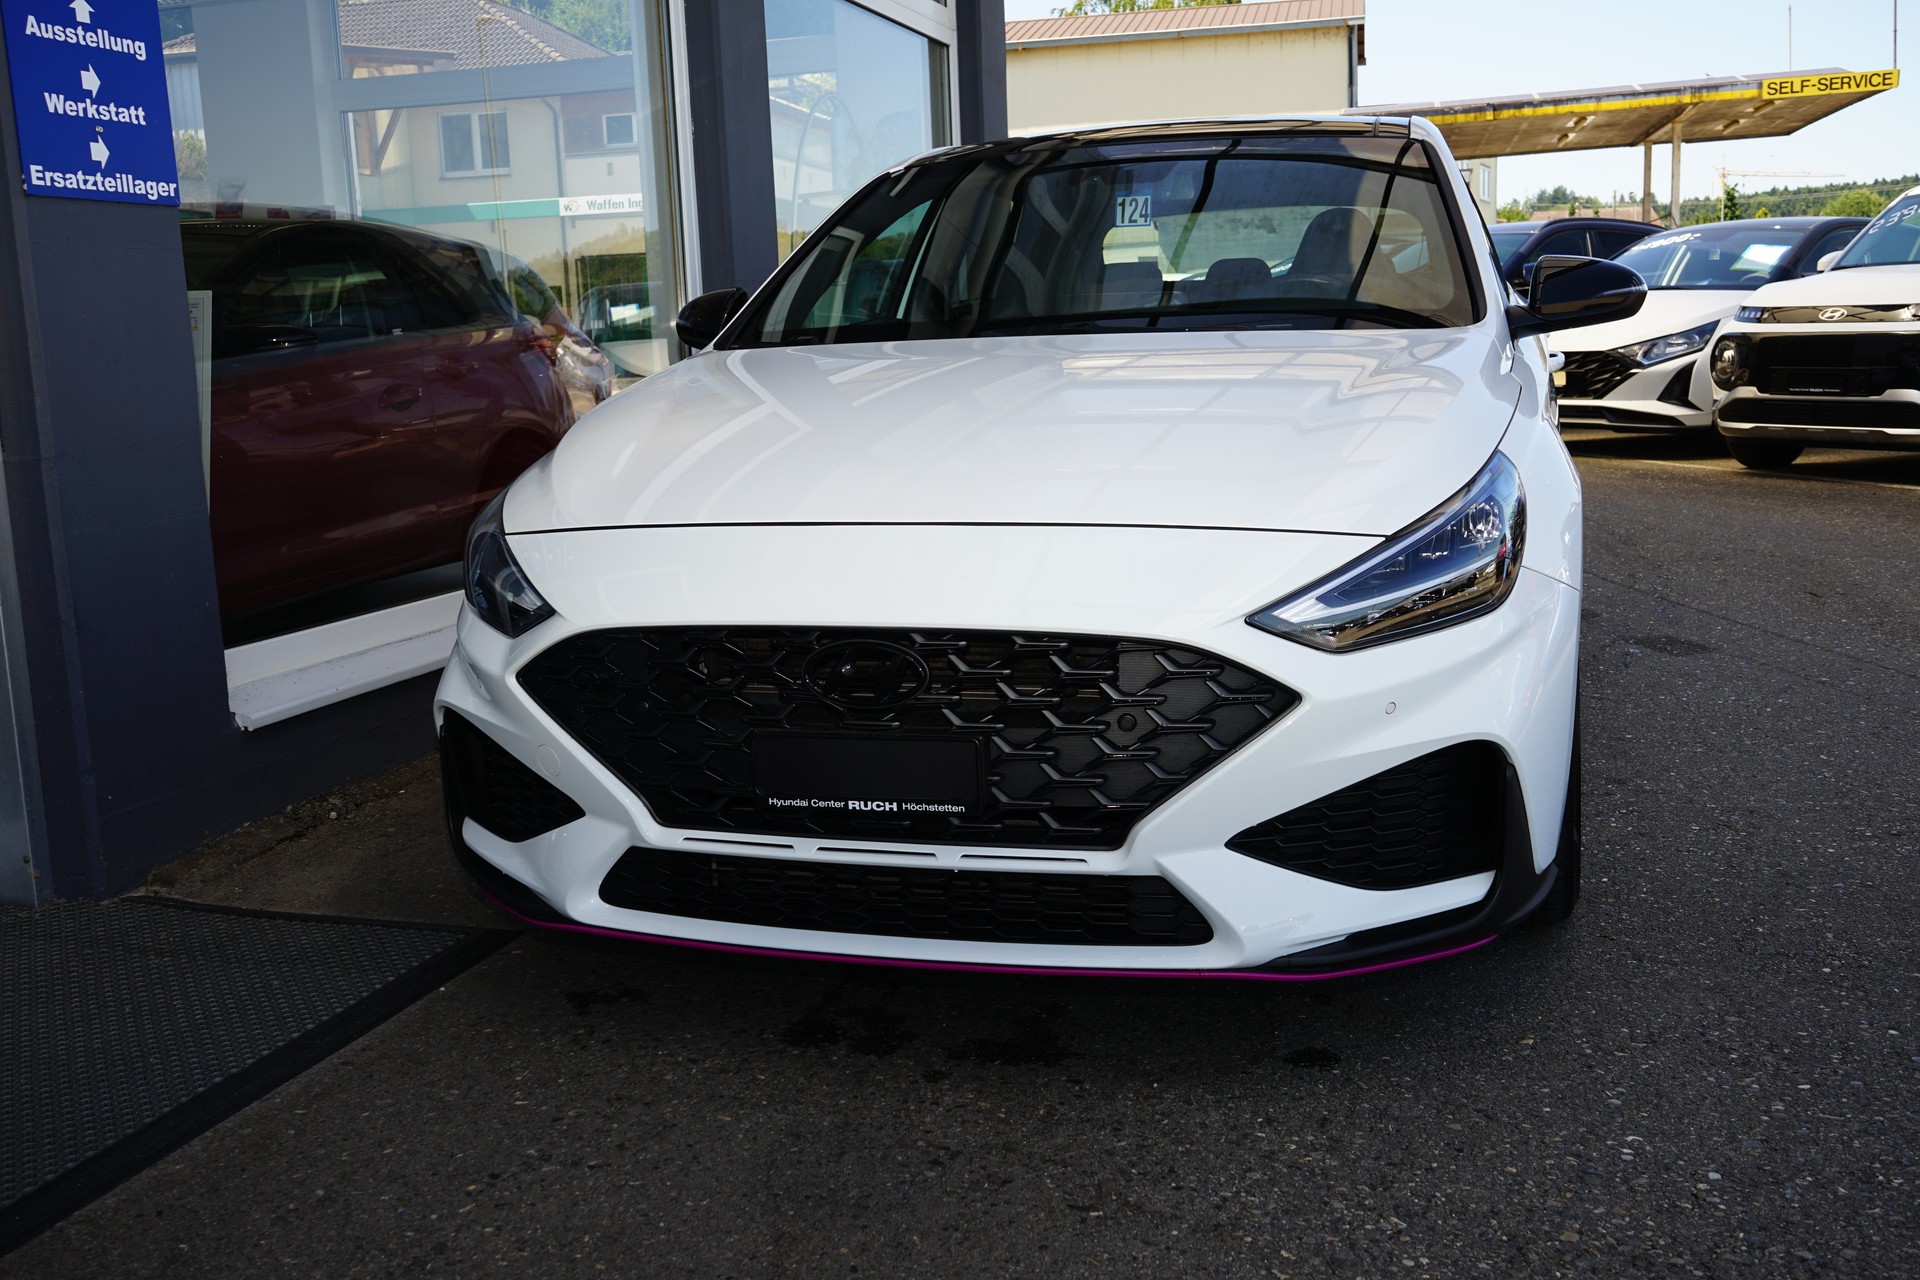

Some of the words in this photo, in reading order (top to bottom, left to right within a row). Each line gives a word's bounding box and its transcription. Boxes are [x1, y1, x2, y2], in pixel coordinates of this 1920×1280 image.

[25, 14, 147, 61] Ausstellung
[1766, 72, 1893, 96] SELF-SERVICE
[43, 92, 147, 126] Werkstatt
[29, 164, 177, 200] Ersatzteillager
[586, 198, 625, 211] Waffen
[1118, 197, 1150, 224] 124
[1868, 204, 1920, 234] 23'9
[768, 797, 809, 808] Hyundai
[810, 798, 846, 808] Center
[848, 800, 898, 812] RUCH
[902, 802, 966, 813] Höchstetten
